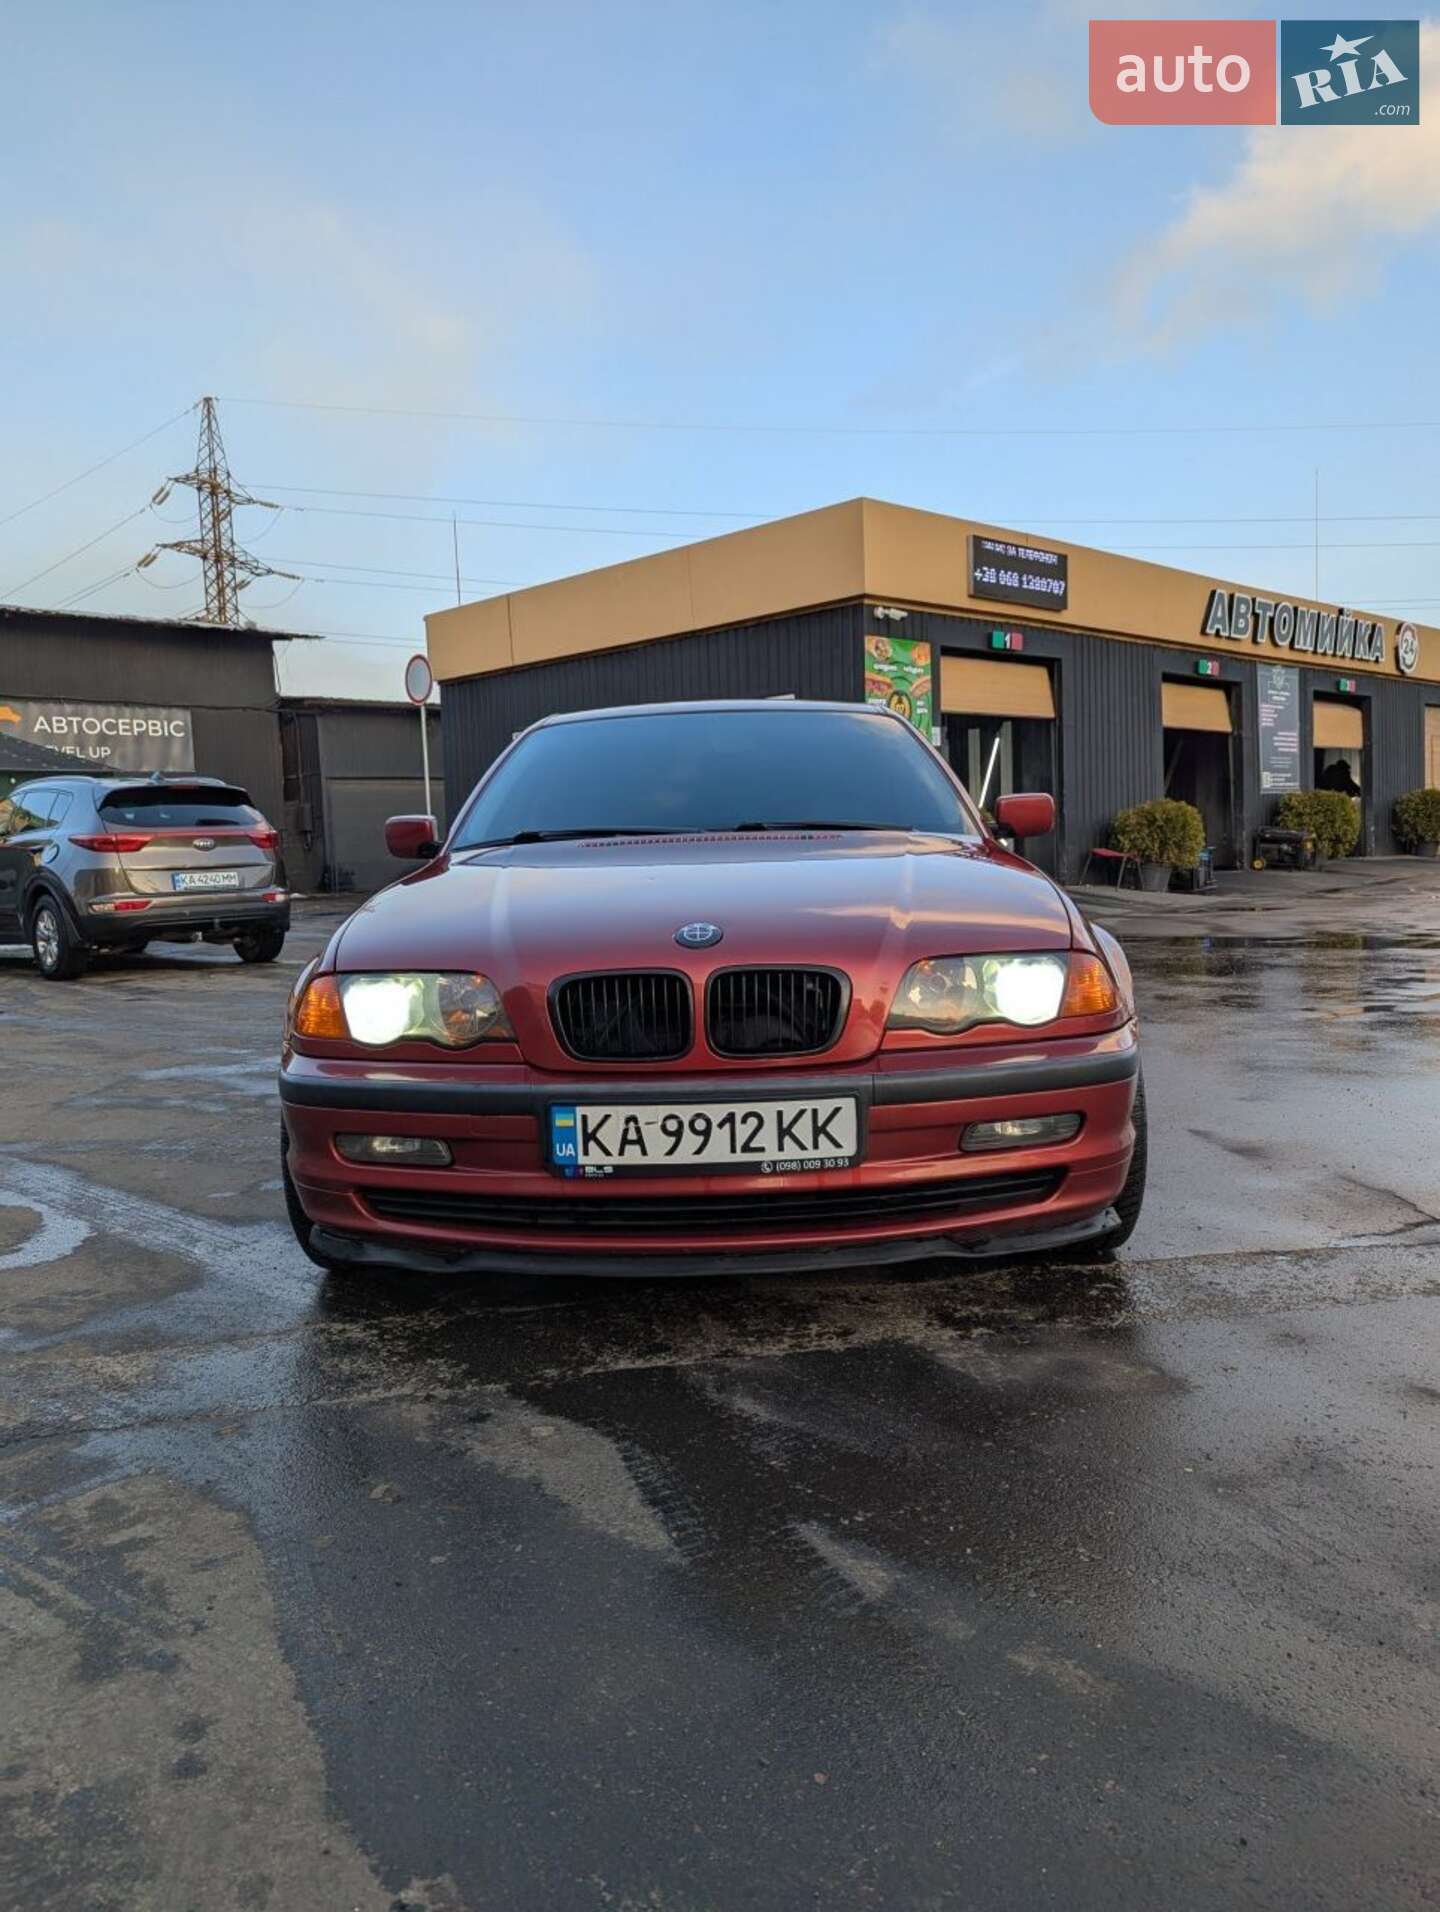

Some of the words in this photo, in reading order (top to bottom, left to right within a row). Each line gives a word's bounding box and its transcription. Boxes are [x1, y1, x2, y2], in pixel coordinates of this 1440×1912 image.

[1205, 588, 1385, 662] АВТОМИЙКА
[33, 715, 186, 738] АВТОСЕРВІС
[88, 746, 112, 759] UP
[580, 1113, 649, 1157] KA
[660, 1110, 766, 1157] 9912
[776, 1105, 844, 1153] KK
[555, 1142, 576, 1157] UA
